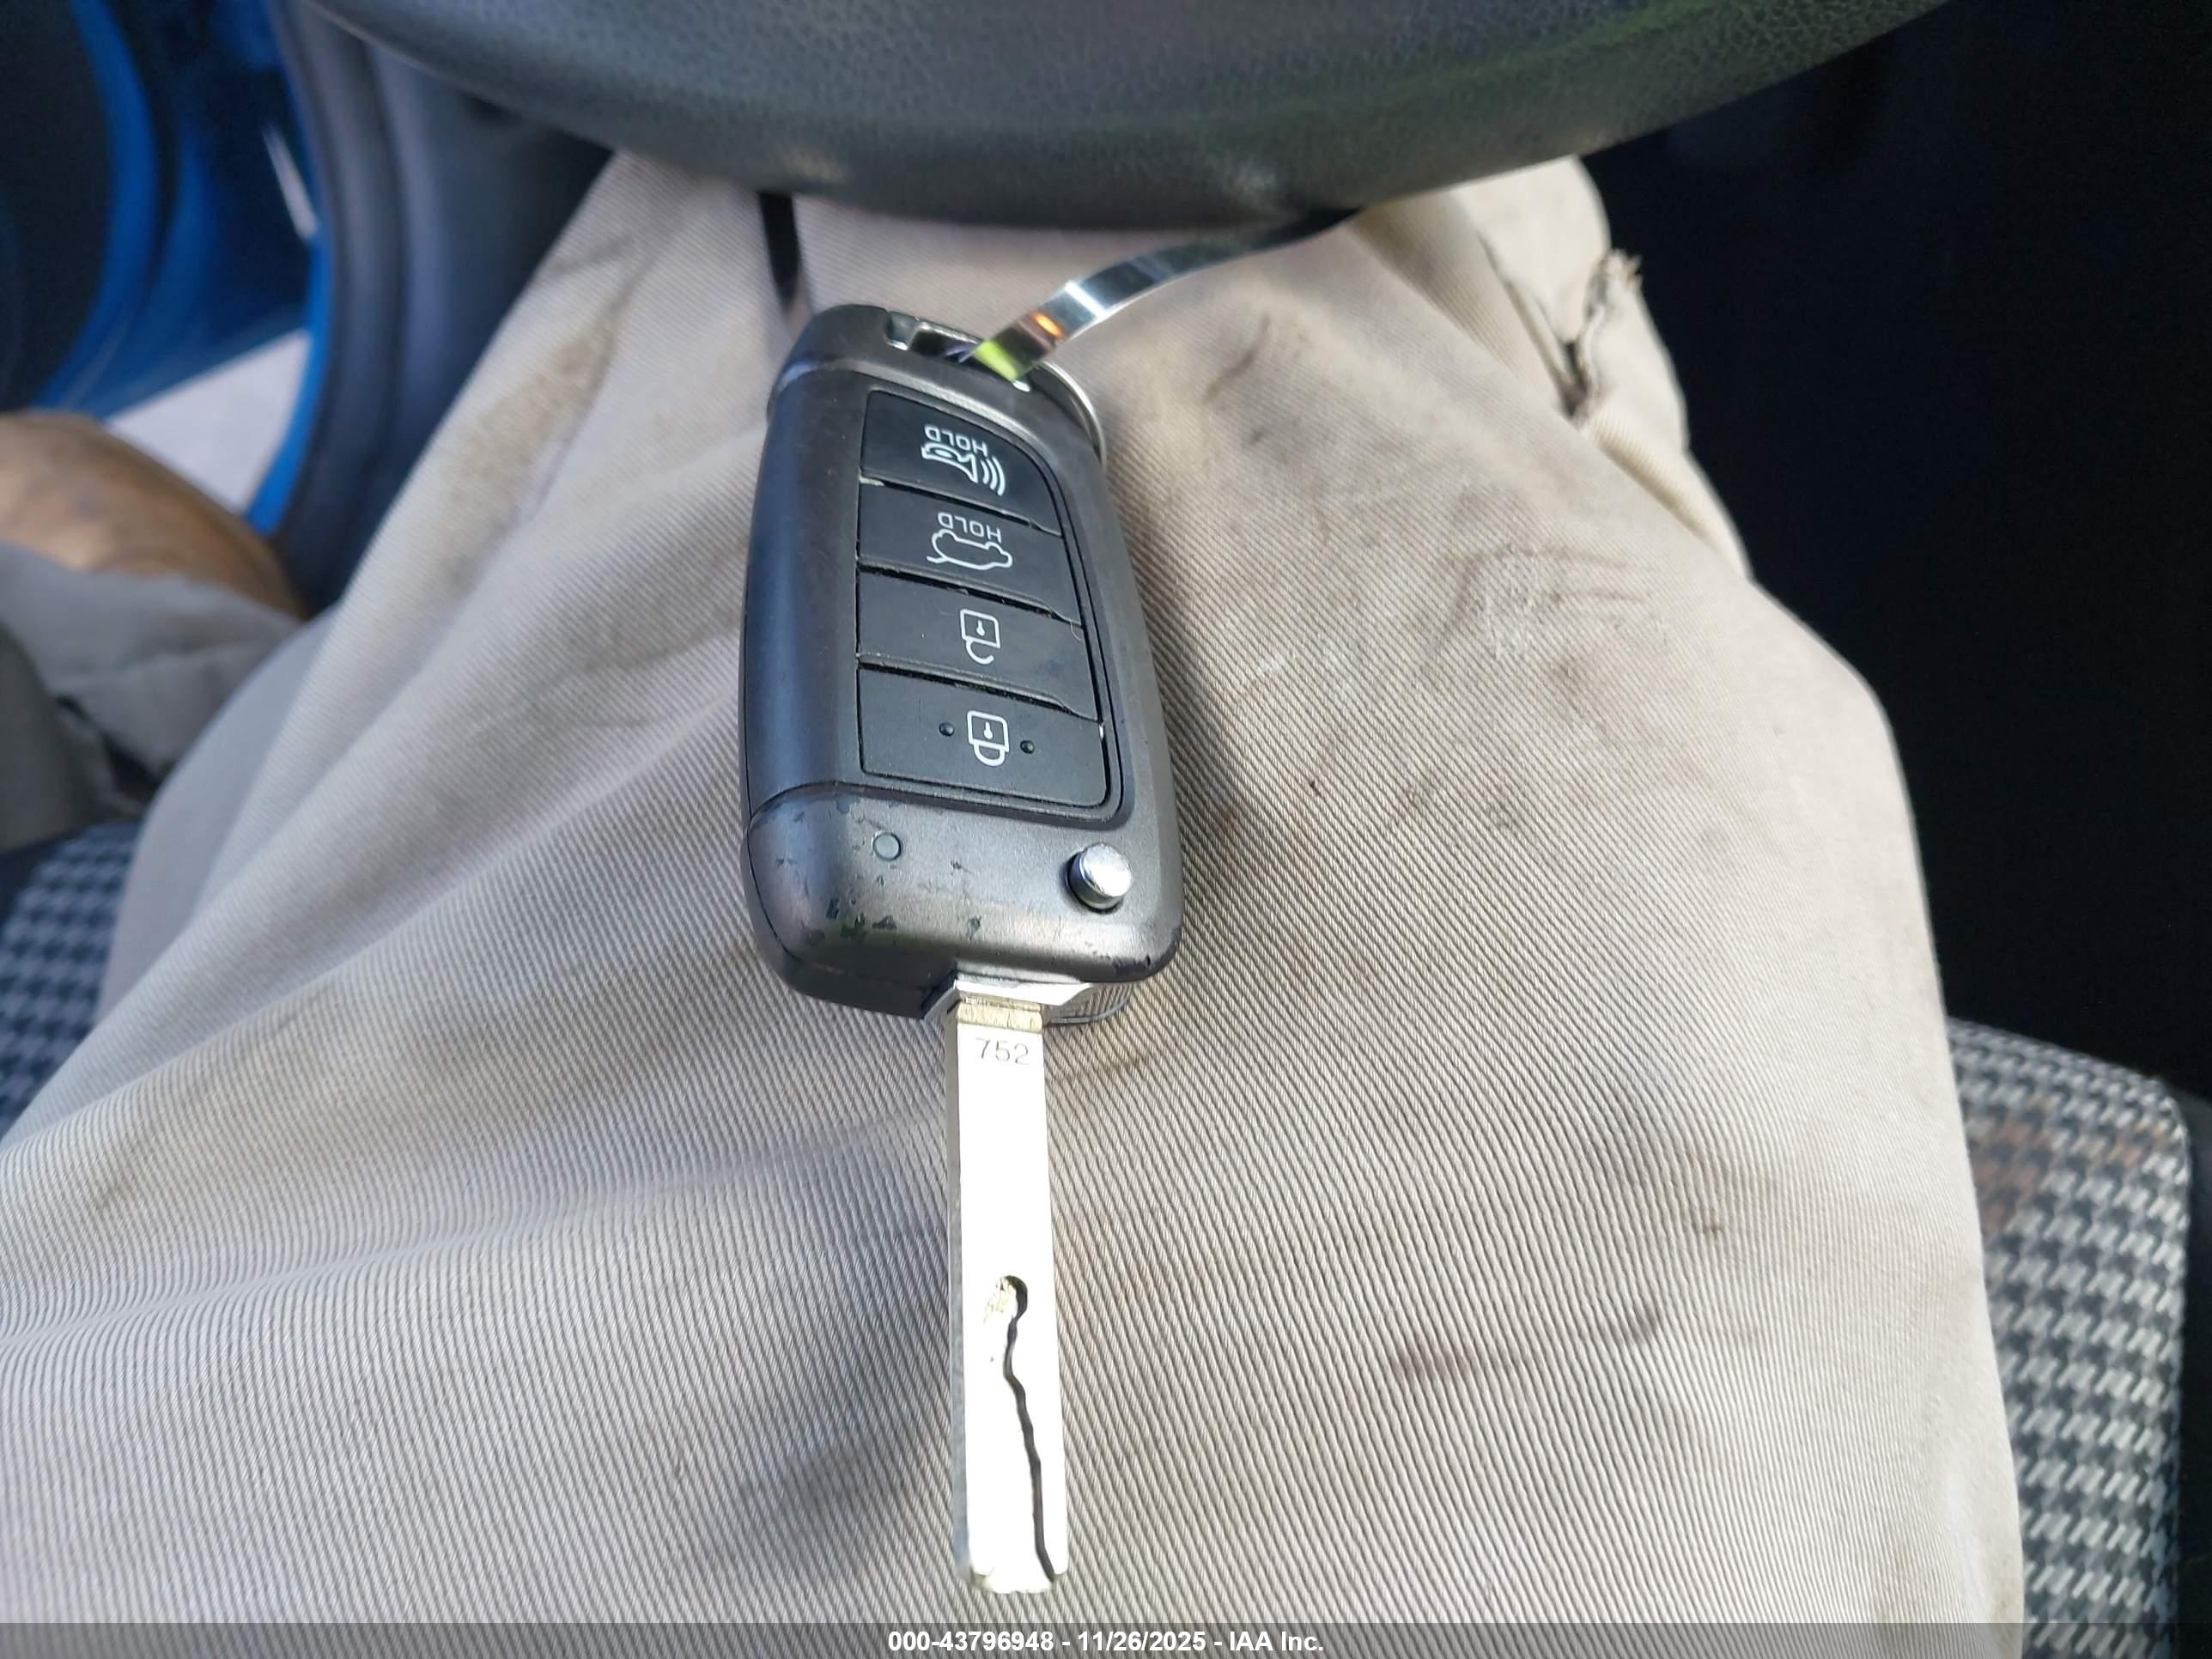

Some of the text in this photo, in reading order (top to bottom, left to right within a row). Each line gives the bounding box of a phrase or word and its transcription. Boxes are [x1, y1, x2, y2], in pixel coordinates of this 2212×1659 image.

[925, 425, 988, 456] HOLD
[938, 513, 1002, 543] HOLD
[975, 1037, 1029, 1065] 752
